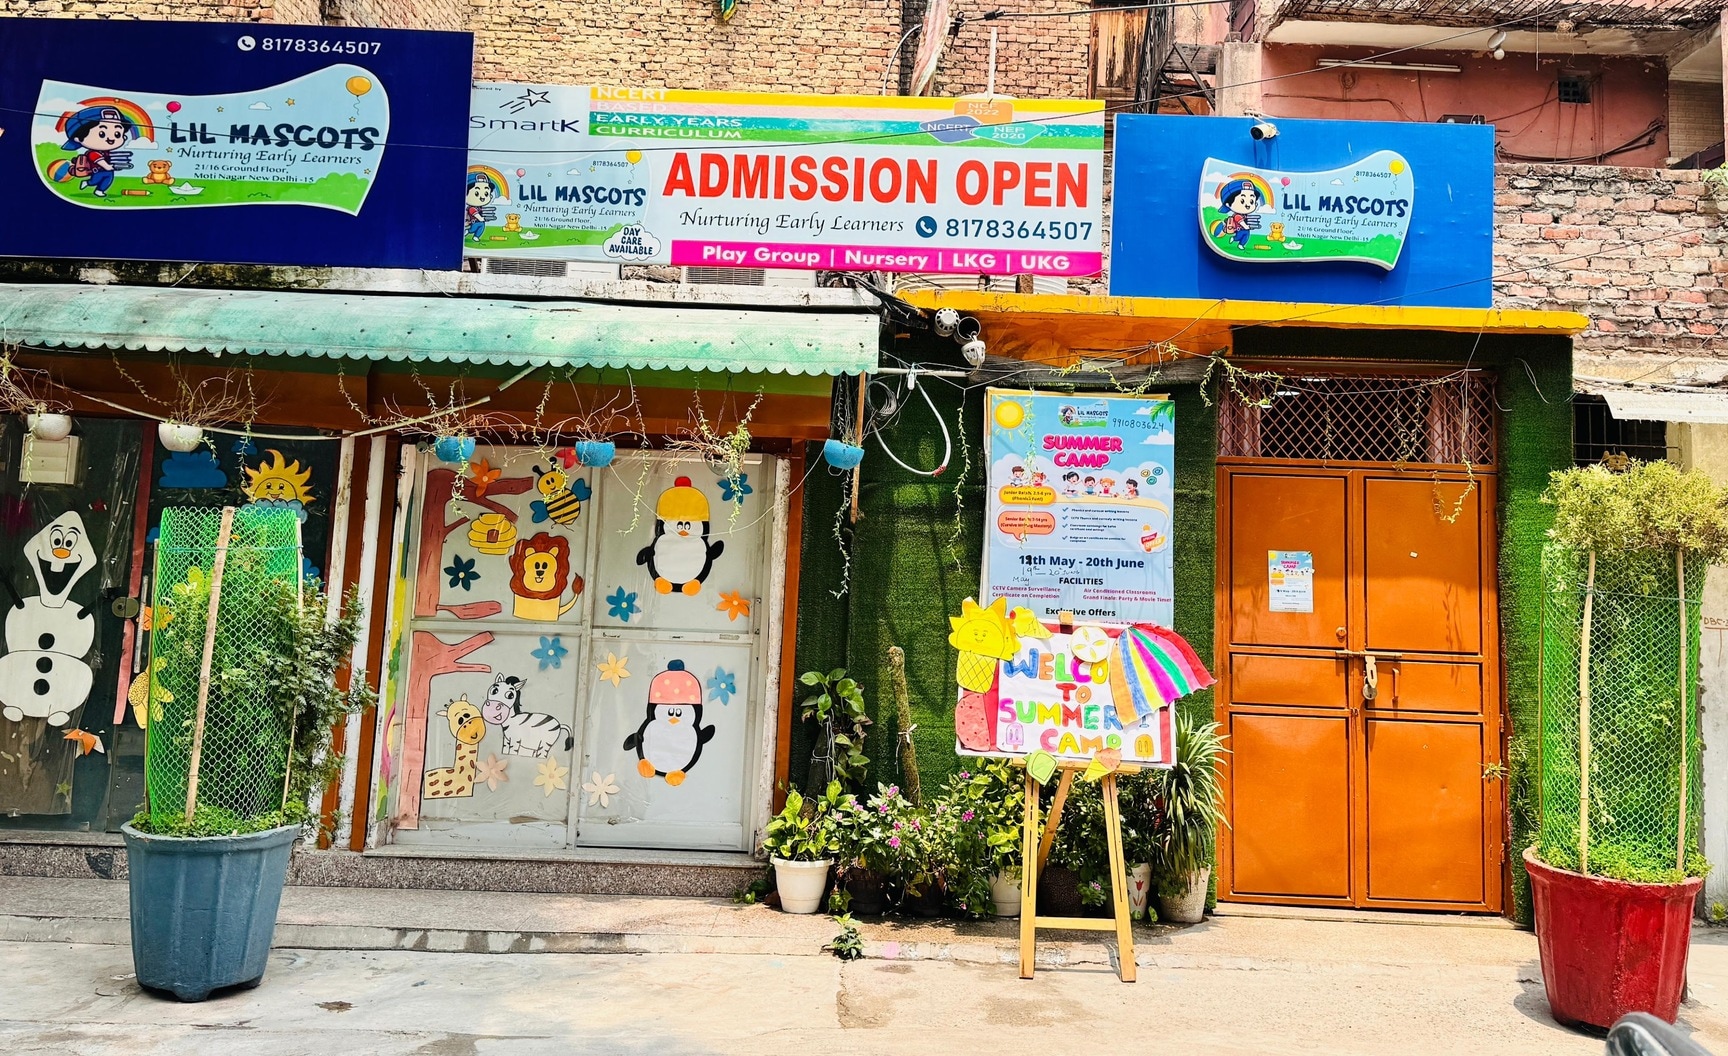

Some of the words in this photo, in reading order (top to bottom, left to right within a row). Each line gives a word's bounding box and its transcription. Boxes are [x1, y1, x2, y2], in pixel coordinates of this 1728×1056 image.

[262, 38, 381, 55] 8178364507
[596, 87, 667, 100] NCERT
[596, 102, 667, 112] BASED
[470, 115, 580, 133] SmartK
[596, 114, 665, 124] EARLY
[670, 116, 742, 127] YEARS
[928, 124, 971, 132] NCERT
[170, 122, 216, 144] LIL
[230, 123, 380, 150] MASCOTS
[596, 126, 742, 138] CURRICULUM
[177, 145, 251, 164] Nurturing
[256, 150, 297, 166] Early
[300, 152, 362, 164] Learners
[218, 174, 248, 182] Nagar
[662, 152, 938, 204] ADMISSION
[956, 160, 1089, 208] OPEN
[519, 184, 548, 201] LIL
[555, 186, 646, 206] MASCOTS
[524, 202, 570, 217] Nurturing
[571, 205, 597, 218] Early
[599, 207, 636, 217] Learners
[1283, 193, 1311, 211] LIL
[1318, 195, 1408, 218] MASCOTS
[680, 208, 770, 235] Nurturing
[774, 212, 826, 237] Early
[830, 214, 904, 232] Learners
[946, 218, 1092, 240] 8178364507
[1287, 212, 1332, 227] Nurturing
[1334, 215, 1359, 229] Early
[1361, 218, 1398, 228] Learners
[623, 227, 641, 236] DAY
[609, 244, 653, 255] AVAILABLE
[621, 237, 642, 246] CARE
[702, 245, 749, 265] Play
[754, 246, 820, 267] Group
[844, 249, 930, 270] Nursery
[952, 253, 996, 269] LKG
[1020, 254, 1070, 270] UKG
[1112, 418, 1164, 432] 9910803624
[1043, 435, 1123, 452] SUMMER
[1054, 452, 1109, 468] CAMP
[1050, 556, 1076, 568] May
[1086, 557, 1113, 567] 20th
[1115, 558, 1144, 569] June
[1004, 648, 1108, 685] WELCO
[1056, 682, 1092, 704] TO
[1000, 698, 1123, 731] SUMMER
[1040, 728, 1122, 754] CAMP
